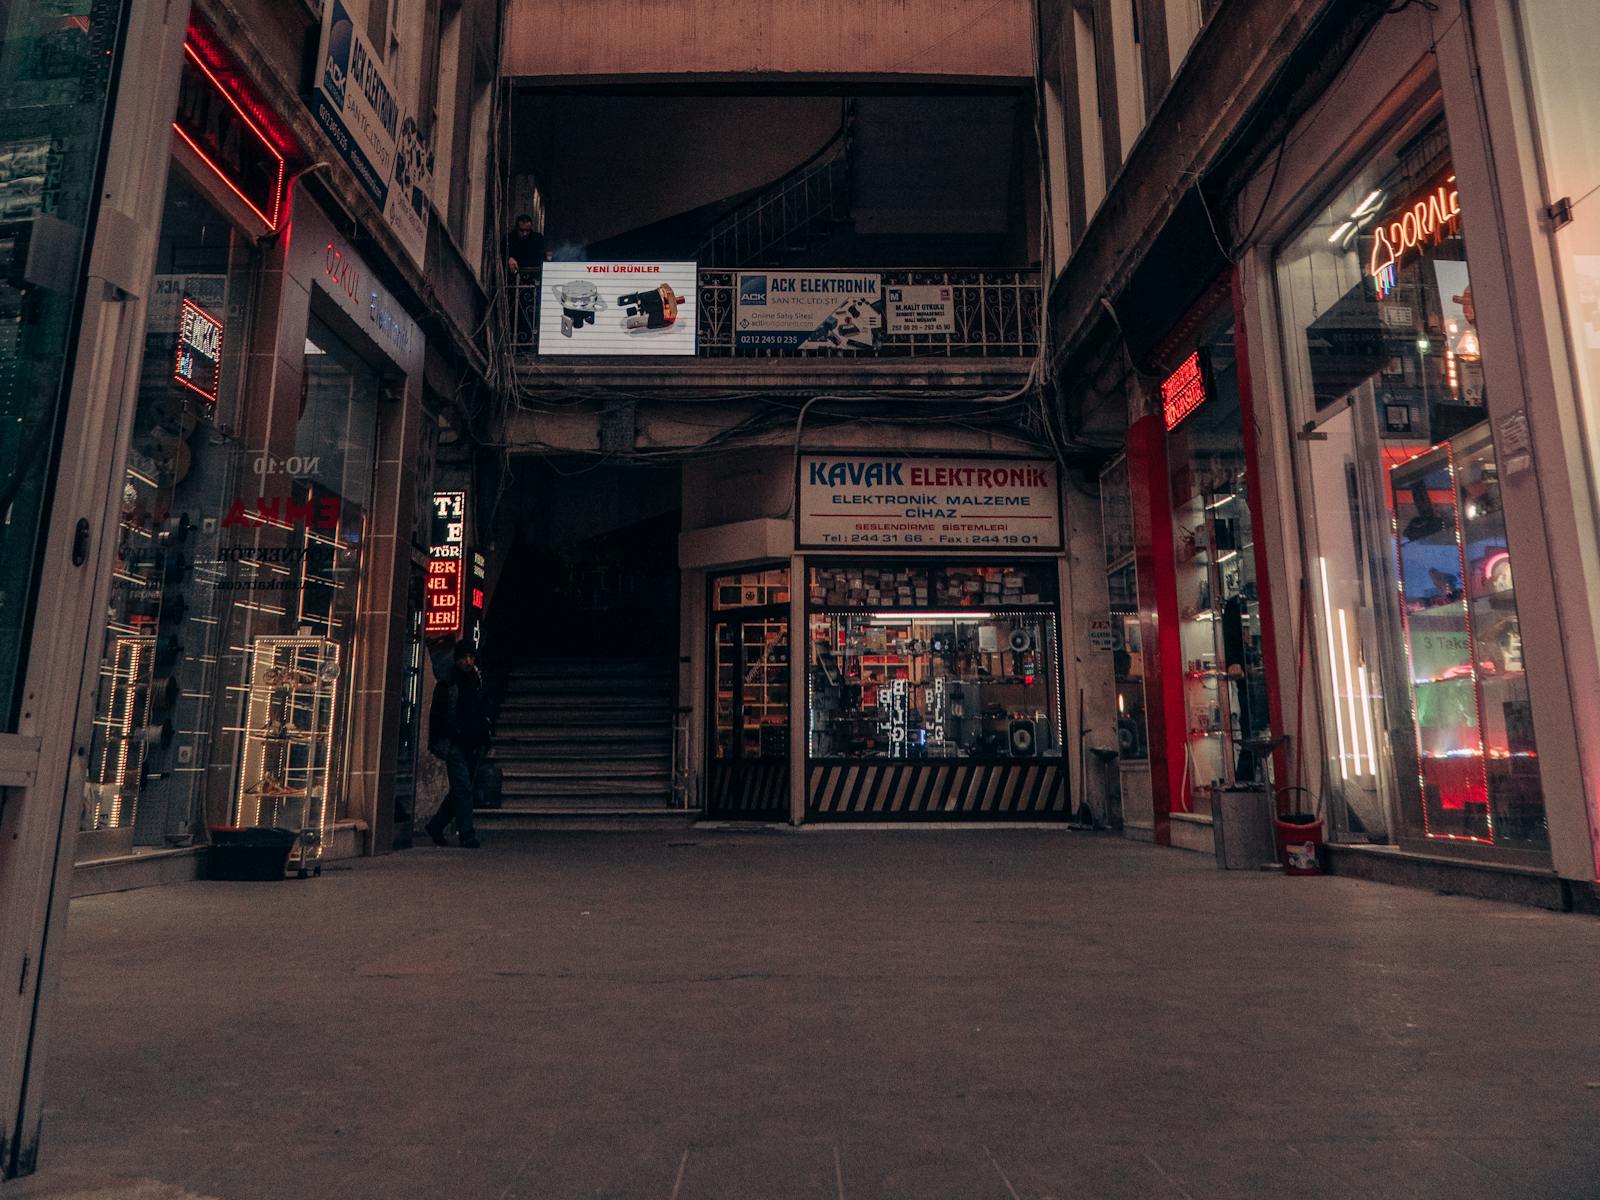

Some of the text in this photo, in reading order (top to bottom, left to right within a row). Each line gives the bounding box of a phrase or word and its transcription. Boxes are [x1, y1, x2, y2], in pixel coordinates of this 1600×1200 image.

[586, 264, 660, 274] YENİ ÜRÜNLER
[771, 277, 876, 293] ACK ELEKTRONİK
[741, 293, 766, 301] ACK
[741, 335, 798, 344] 0212 245 0 235
[809, 462, 1049, 489] KAVAK ELEKTRONİK
[832, 493, 1031, 506] ELEKTRONİK MALZEME
[905, 507, 958, 519] CİHAZ
[855, 523, 1009, 532] SESLENDİRME SİSTEMLERİ
[851, 534, 880, 543] 244
[882, 534, 898, 543] 31
[904, 534, 923, 543] 66
[972, 535, 1000, 544] 244
[1002, 535, 1016, 544] 19
[430, 545, 460, 558] TÖR
[427, 611, 456, 624] LERİ
[1436, 636, 1469, 650] Taks
